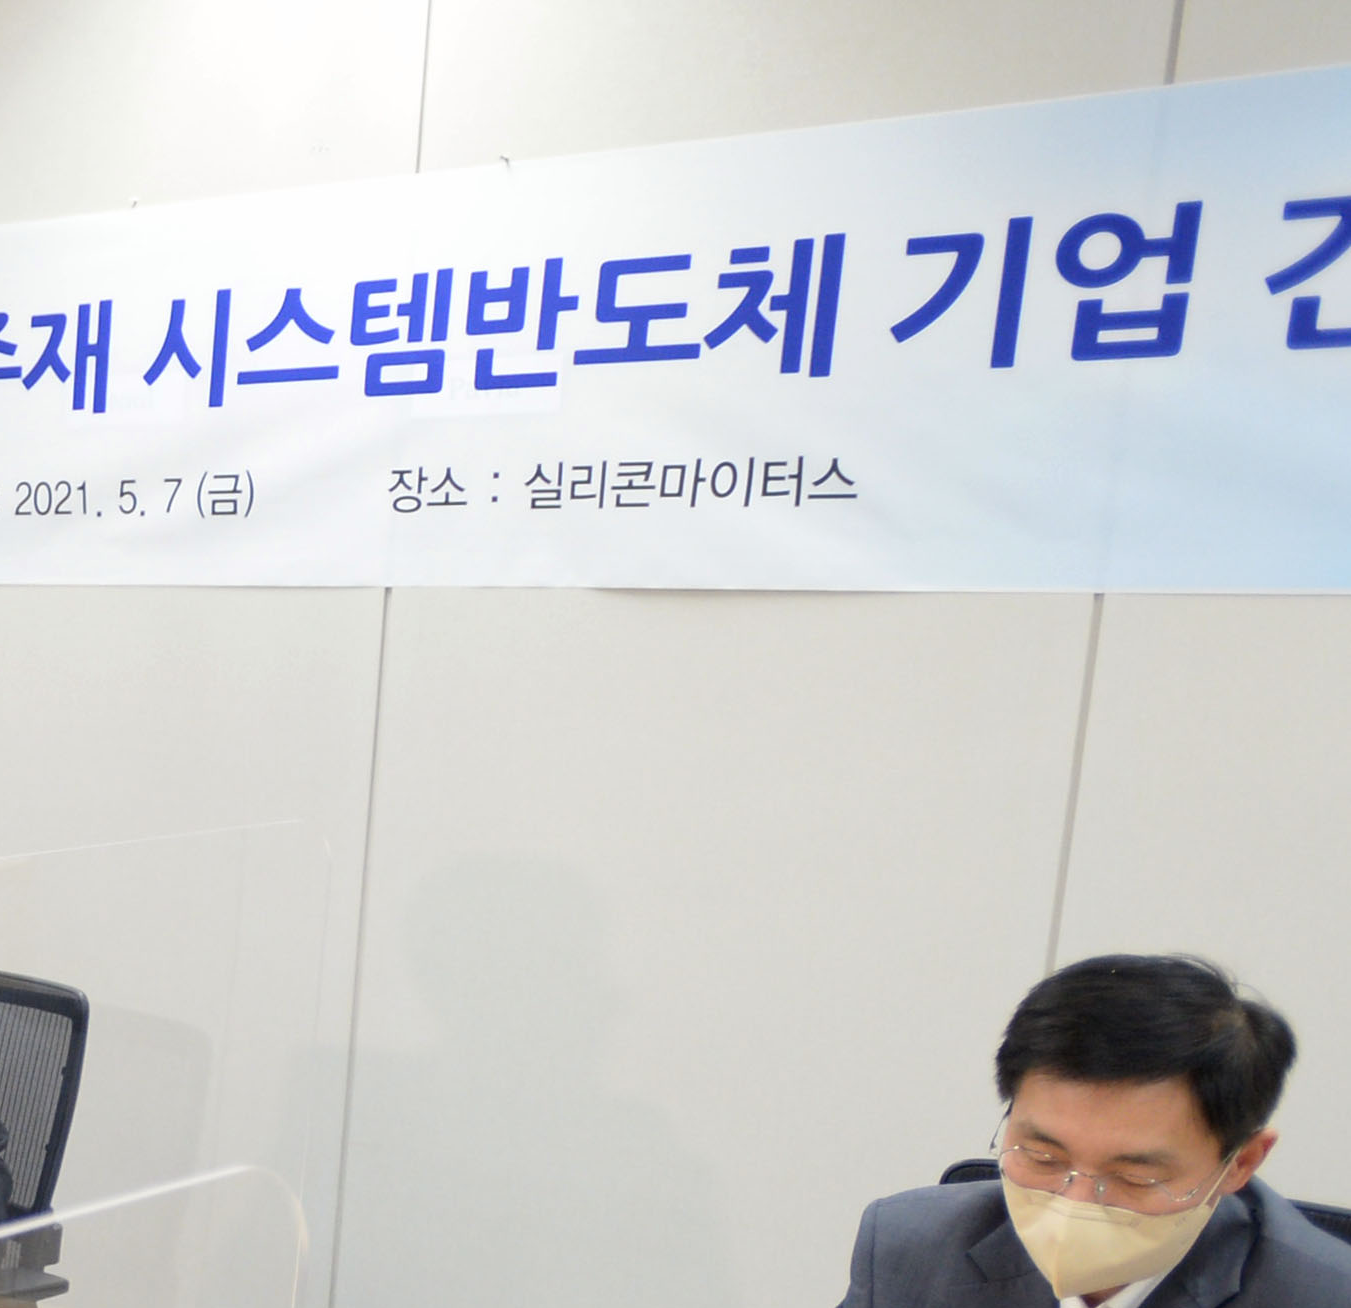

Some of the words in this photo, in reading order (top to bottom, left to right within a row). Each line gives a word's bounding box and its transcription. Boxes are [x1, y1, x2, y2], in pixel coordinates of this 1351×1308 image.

[143, 233, 846, 407] 시스템반도체
[891, 201, 1203, 368] 기업
[196, 470, 255, 519] (금)
[388, 466, 468, 514] 장소
[524, 455, 858, 510] 실리콘마이터스
